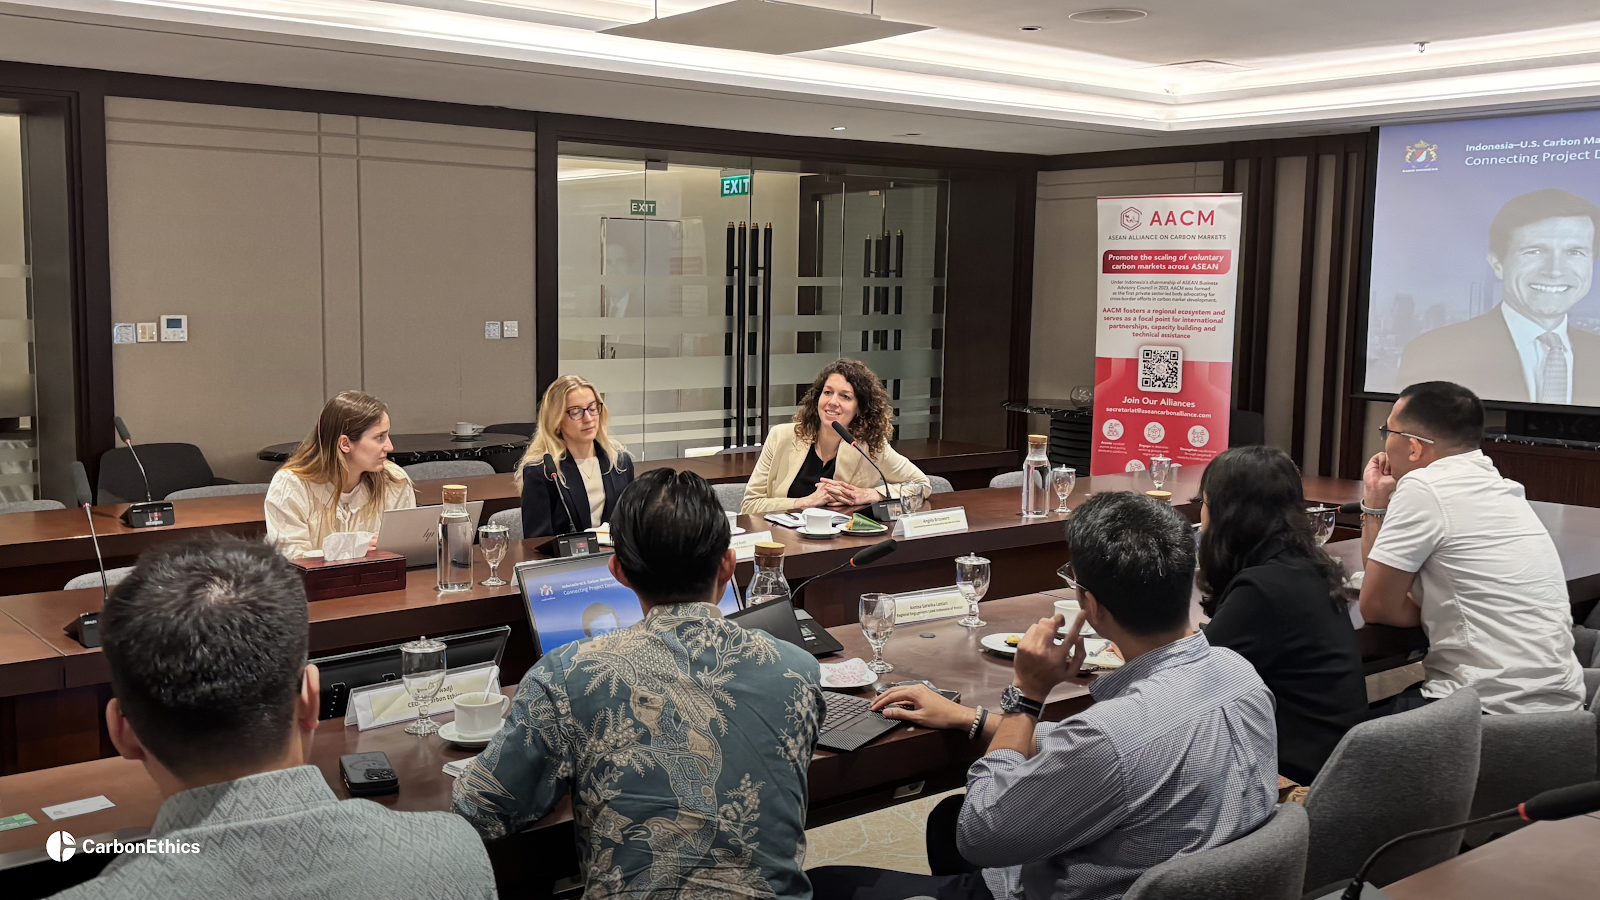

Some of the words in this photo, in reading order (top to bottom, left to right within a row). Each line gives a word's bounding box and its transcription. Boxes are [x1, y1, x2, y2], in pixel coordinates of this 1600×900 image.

[1542, 138, 1580, 146] Carbon
[1464, 154, 1539, 166] Connecting
[1542, 150, 1590, 163] Project
[723, 179, 750, 194] EXIT
[631, 202, 655, 213] EXIT
[1150, 210, 1214, 226] AACM
[1188, 254, 1224, 262] voluntary
[1122, 396, 1140, 404] Join
[1160, 398, 1196, 408] Alliances
[1106, 407, 1212, 418] secretariat@aseancarbonalliance.com
[563, 587, 588, 596] Connecting
